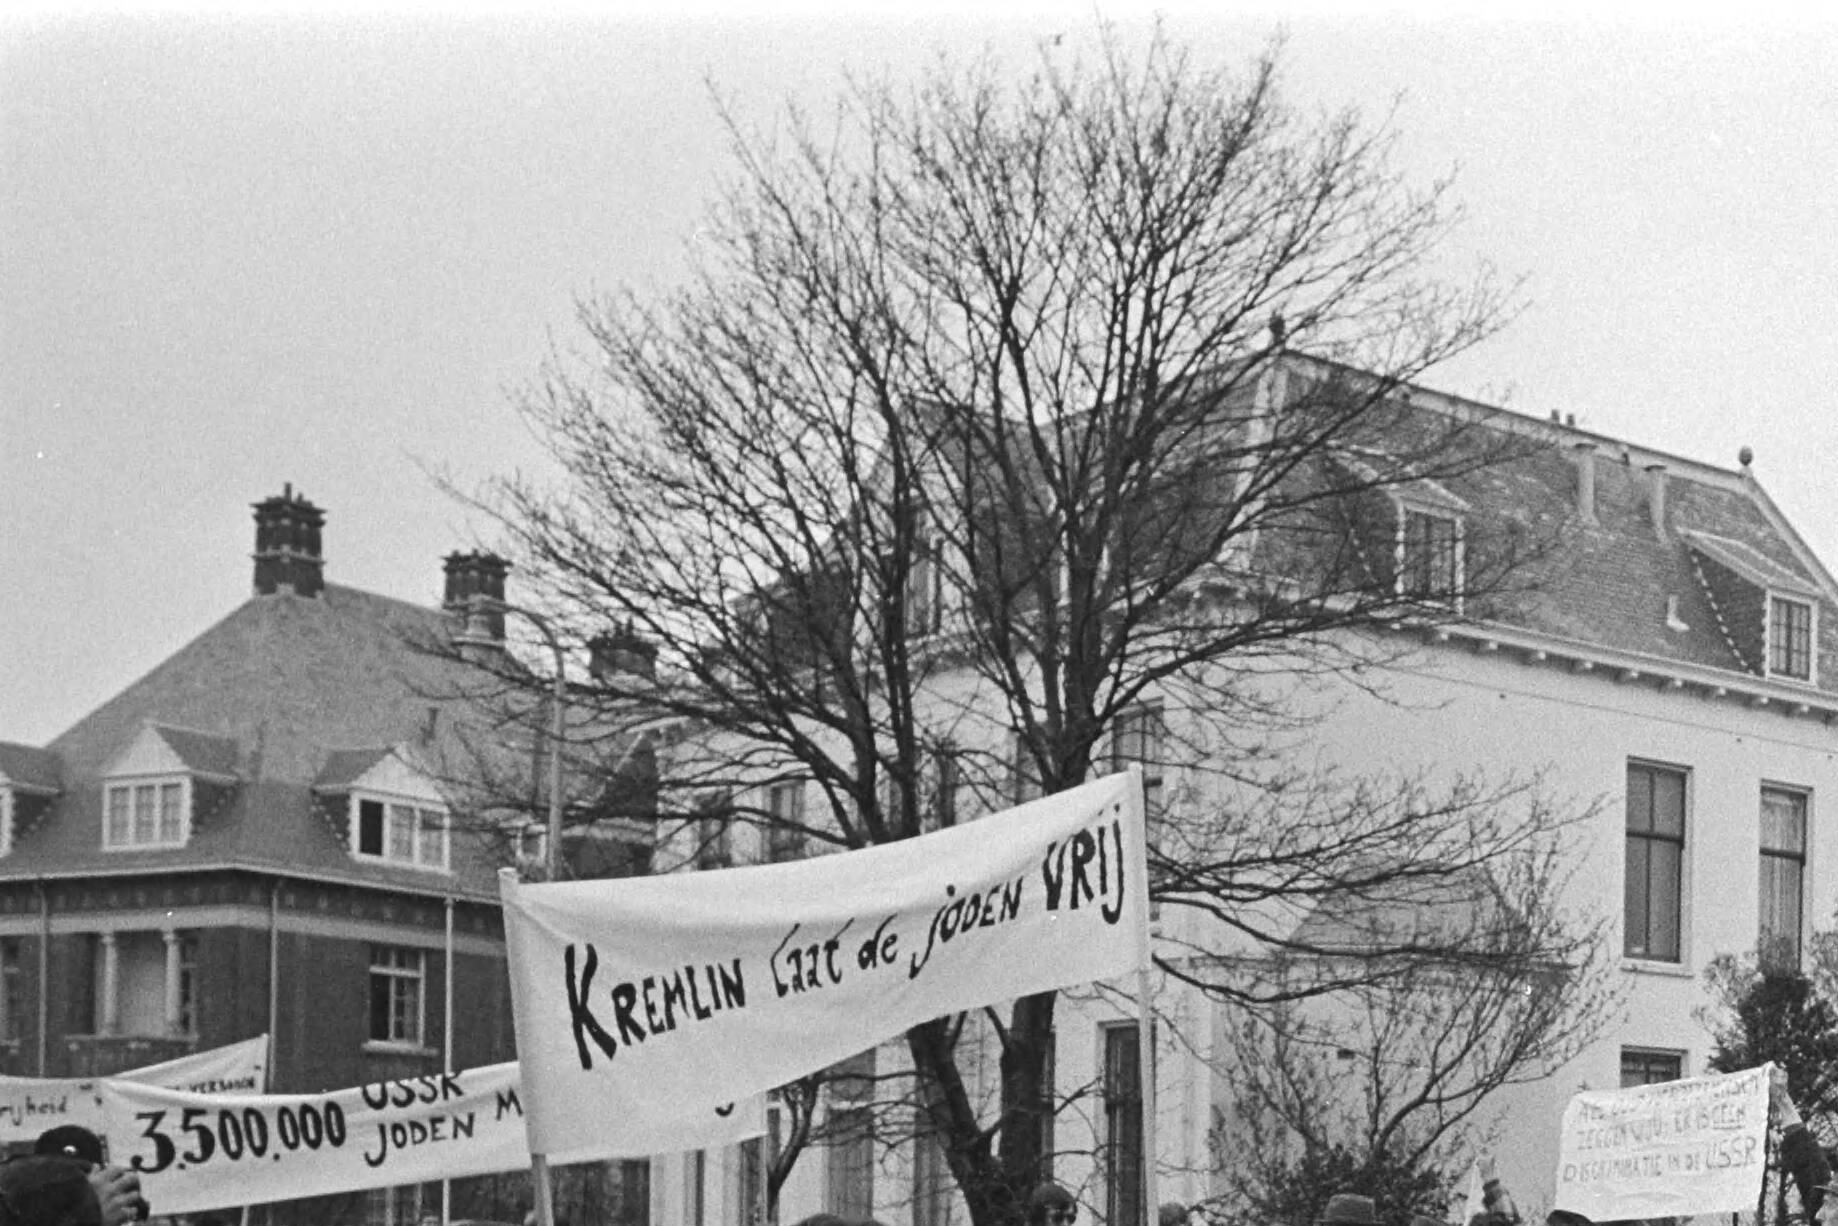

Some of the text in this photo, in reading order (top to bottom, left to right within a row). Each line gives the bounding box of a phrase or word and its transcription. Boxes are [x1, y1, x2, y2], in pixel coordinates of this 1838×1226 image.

[565, 943, 746, 1070] KREMLIN
[858, 914, 898, 970] de
[131, 1101, 347, 1174] 3.500.000
[365, 1111, 476, 1168] JODEN
